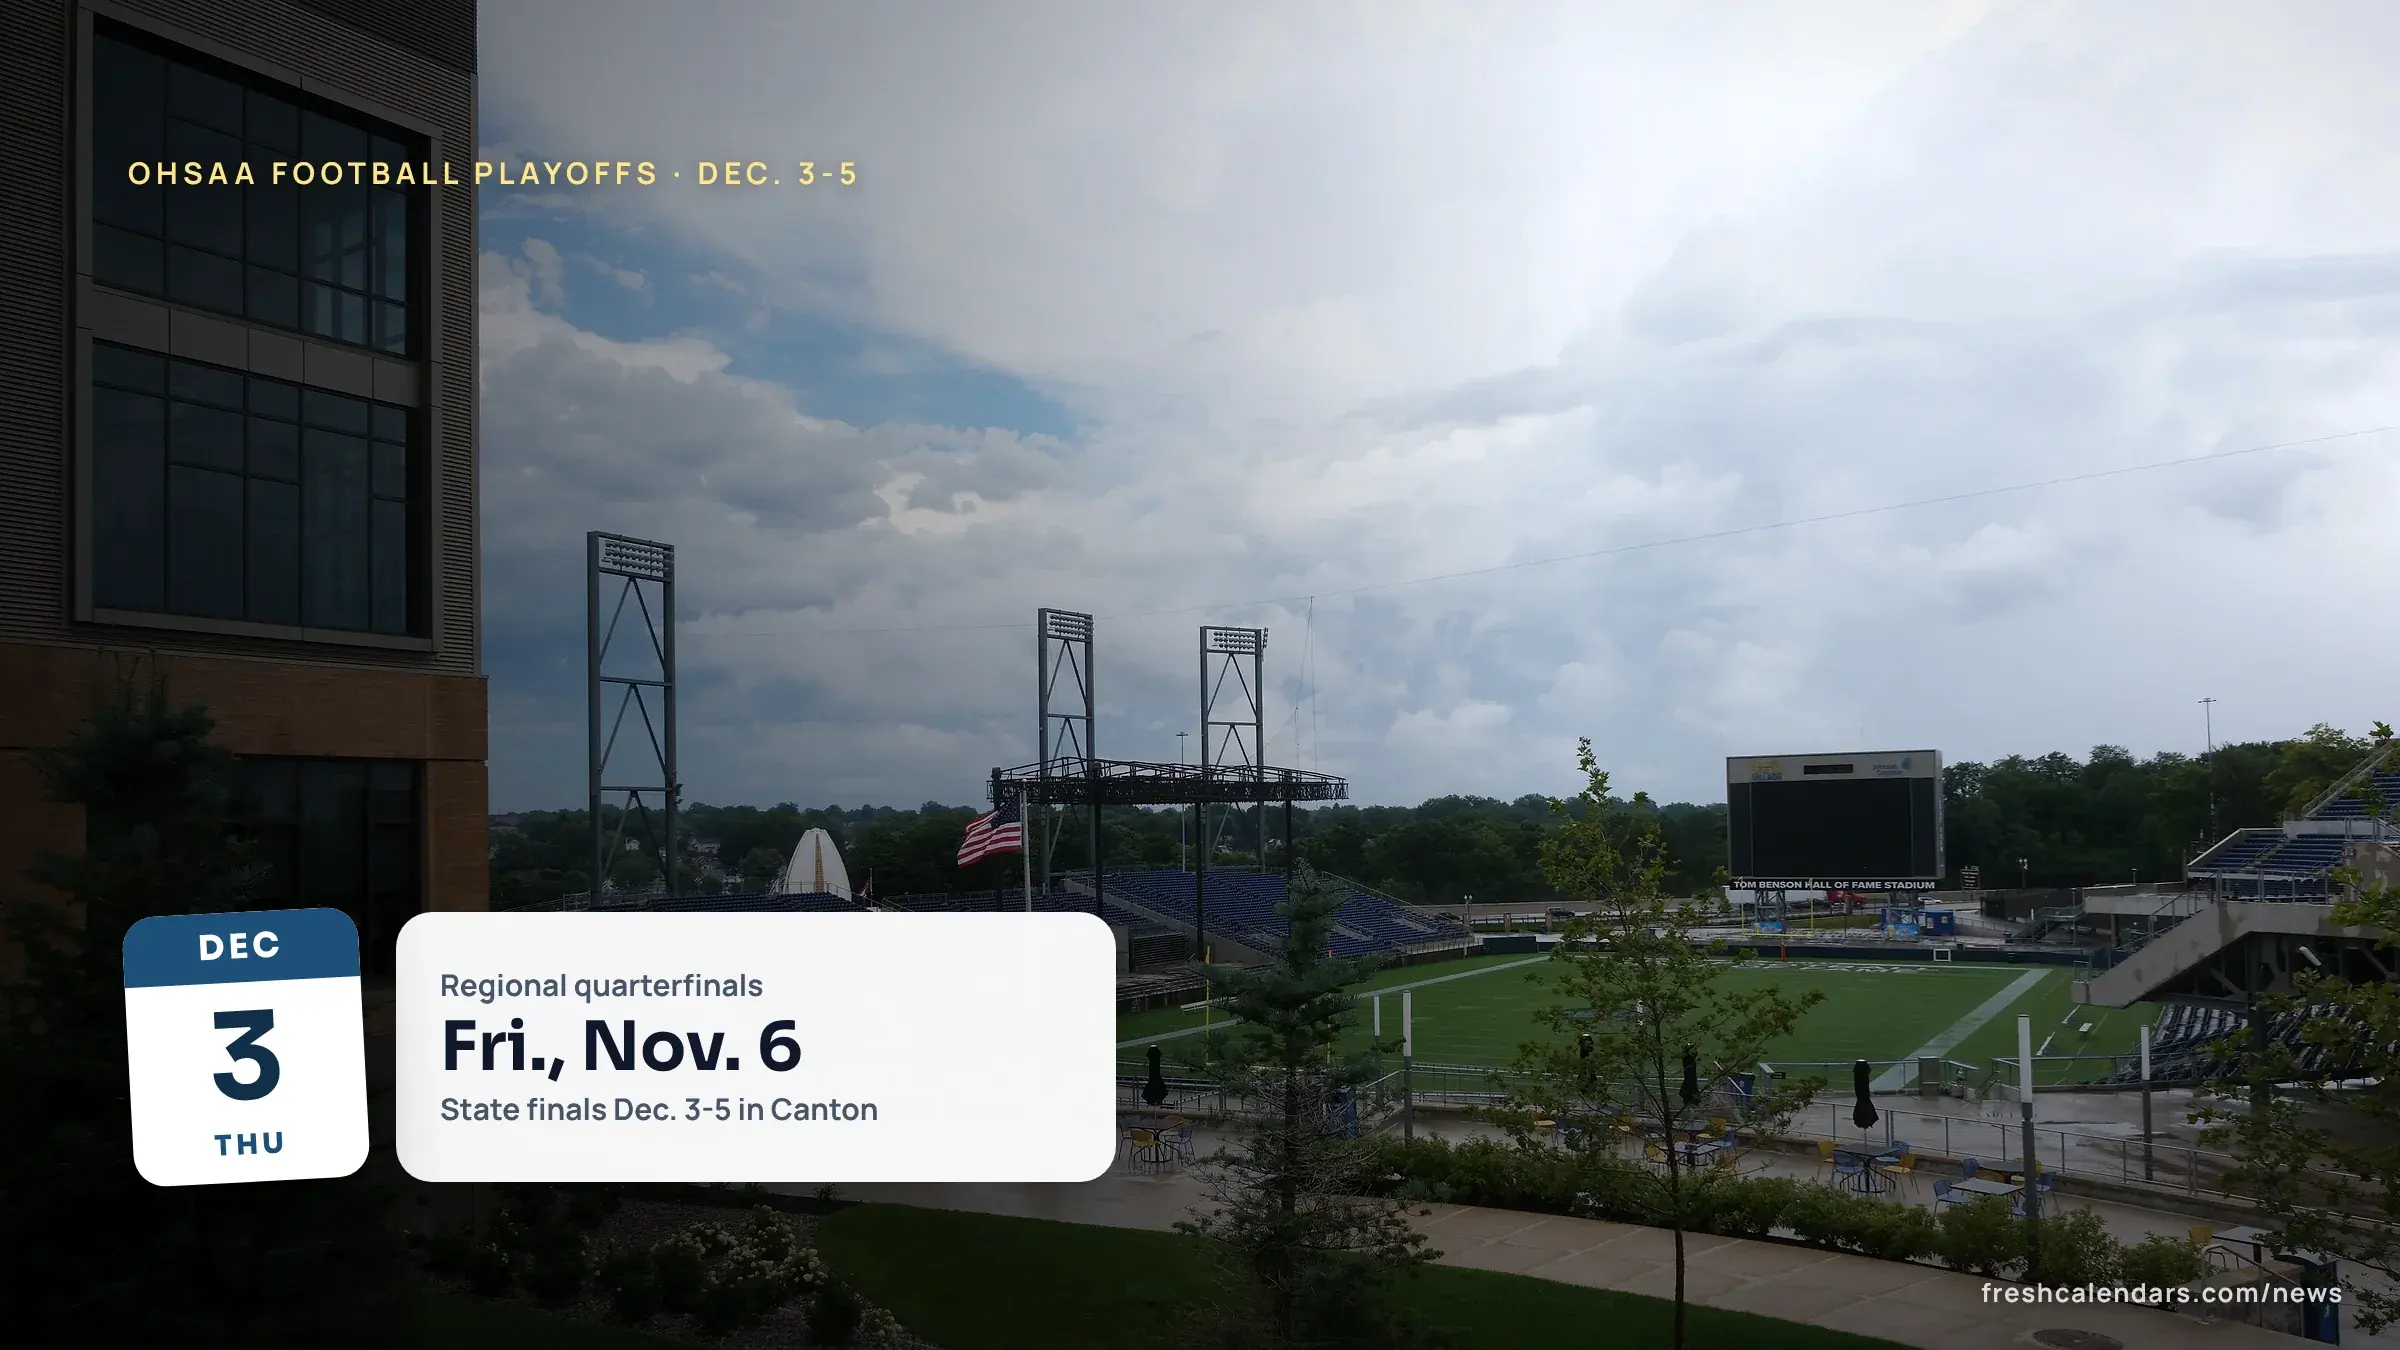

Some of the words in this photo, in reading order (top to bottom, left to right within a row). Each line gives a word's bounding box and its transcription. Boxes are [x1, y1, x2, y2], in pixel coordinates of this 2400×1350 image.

[1733, 881, 1756, 889] TOM
[1759, 881, 1802, 889] BENSON
[1805, 881, 1832, 889] HALL
[1834, 881, 1849, 889] OF
[1852, 881, 1881, 889] FAME
[1884, 881, 1935, 889] STADIUM
